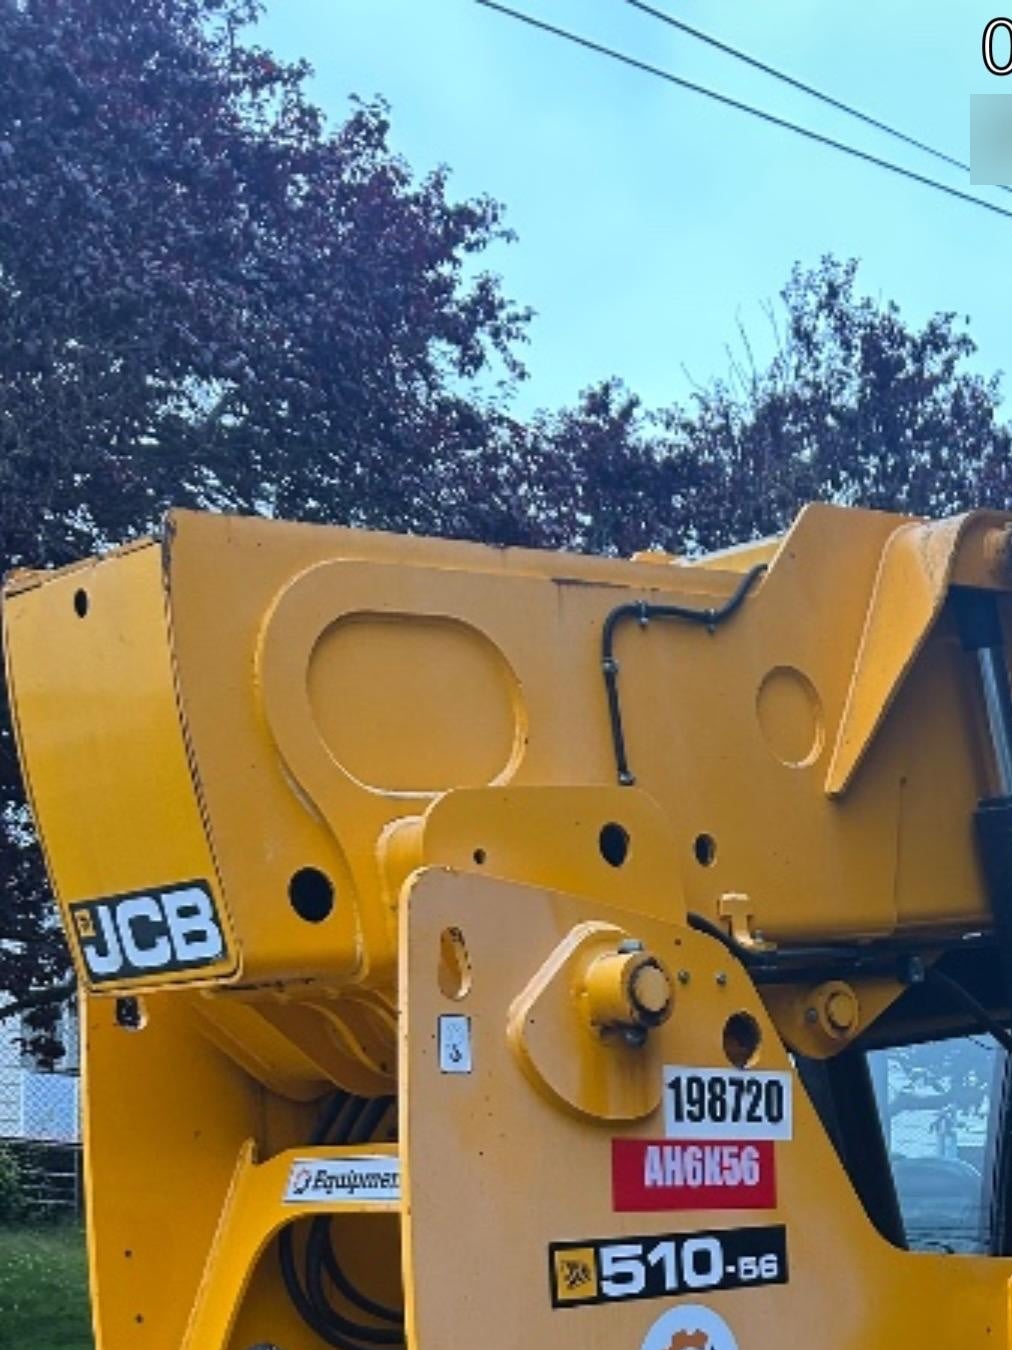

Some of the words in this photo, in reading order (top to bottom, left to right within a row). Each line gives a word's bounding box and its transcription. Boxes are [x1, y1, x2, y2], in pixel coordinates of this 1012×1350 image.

[84, 887, 223, 975] JCB
[665, 1076, 785, 1123] 198720
[643, 1145, 761, 1188] AH6K56
